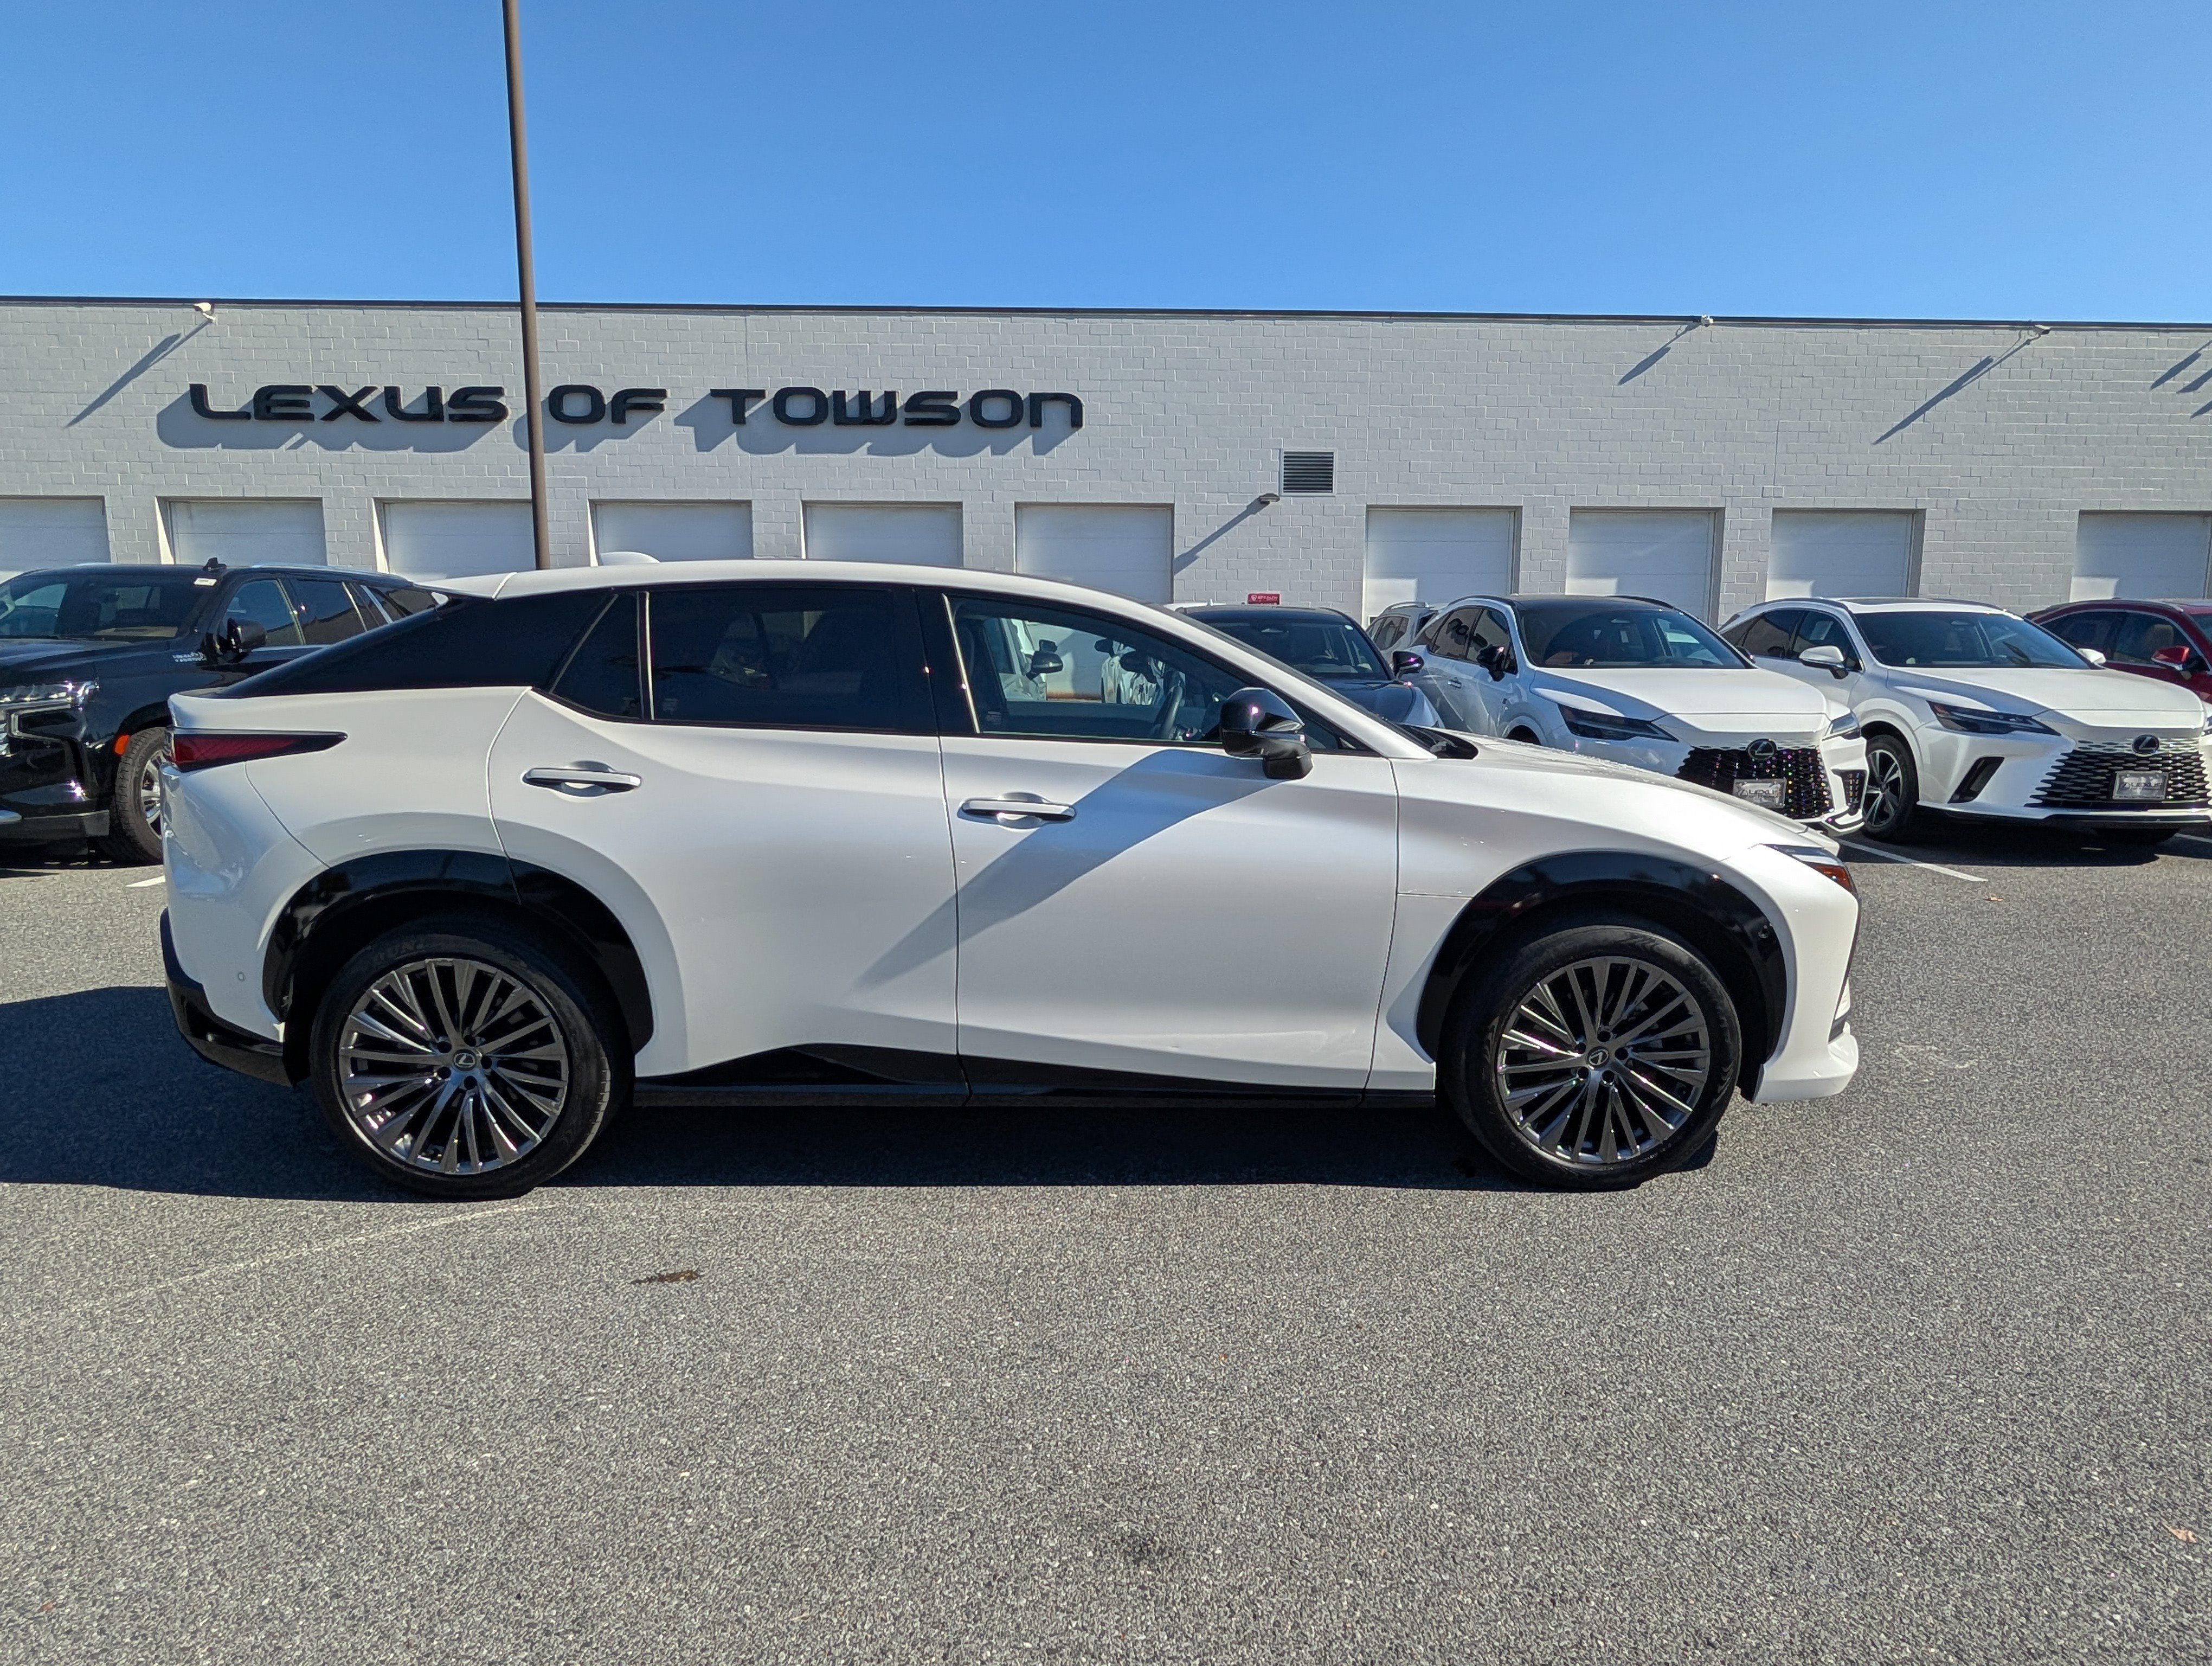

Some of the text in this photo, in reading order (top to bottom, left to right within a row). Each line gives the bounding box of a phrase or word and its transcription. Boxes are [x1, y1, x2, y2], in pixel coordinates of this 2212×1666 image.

[190, 383, 1084, 428] LEXUS OF TOWSON
